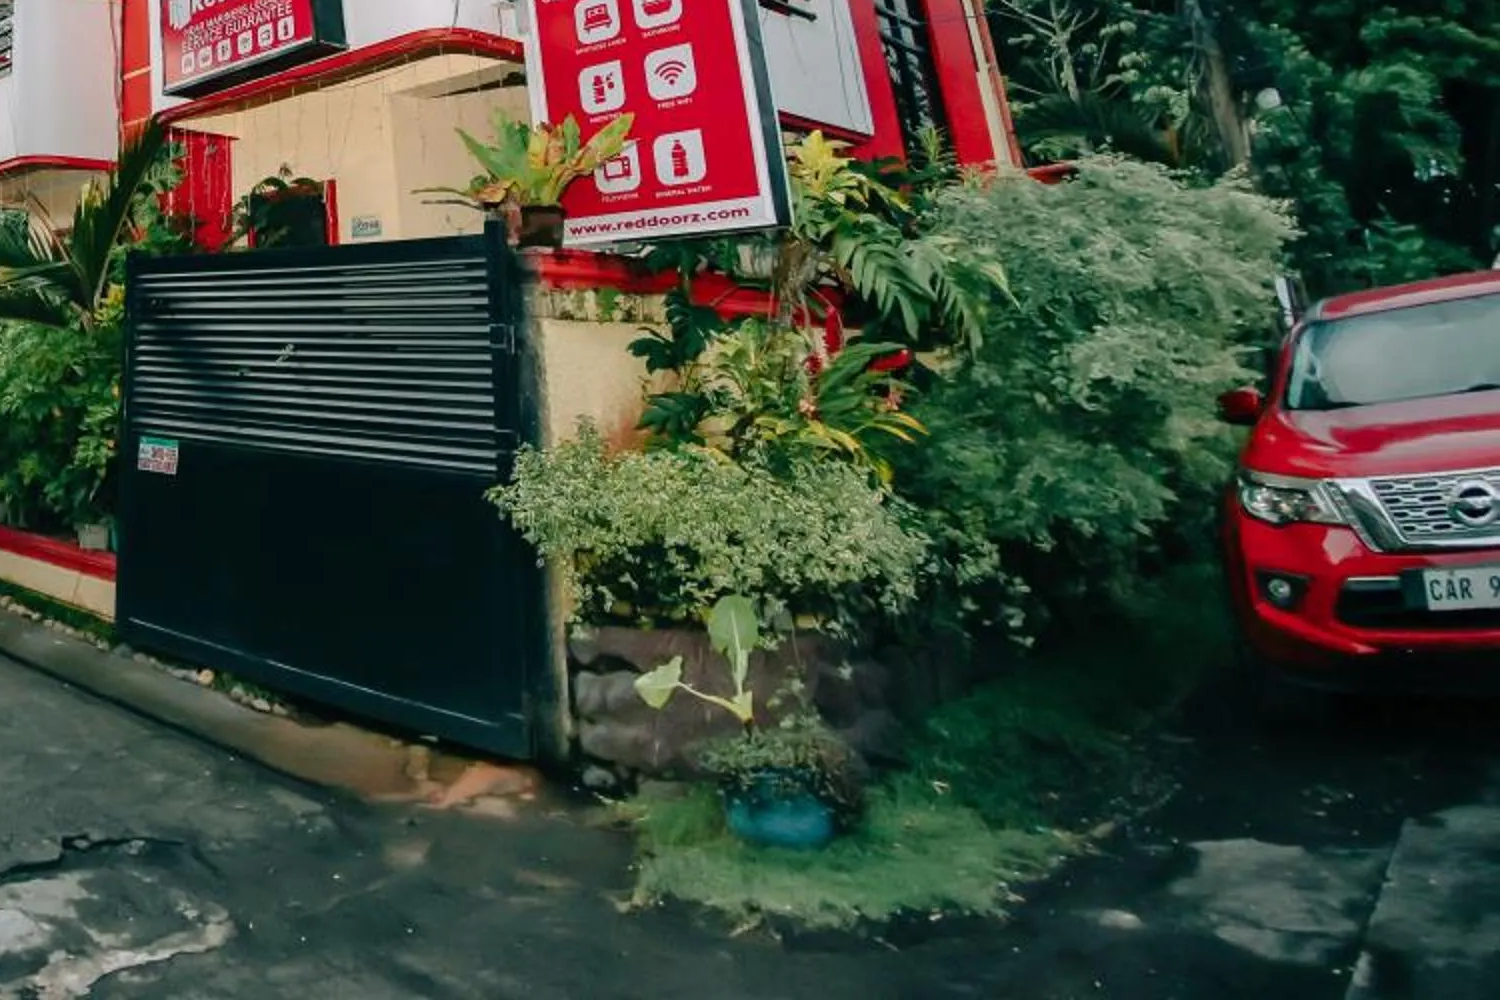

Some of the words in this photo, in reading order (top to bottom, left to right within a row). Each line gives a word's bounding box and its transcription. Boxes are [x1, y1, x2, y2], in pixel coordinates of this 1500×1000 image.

[181, 25, 223, 53] SERVICE
[224, 0, 293, 36] GUARANTEE
[569, 206, 751, 236] www.reddoorz.com
[1429, 577, 1474, 601] CAR
